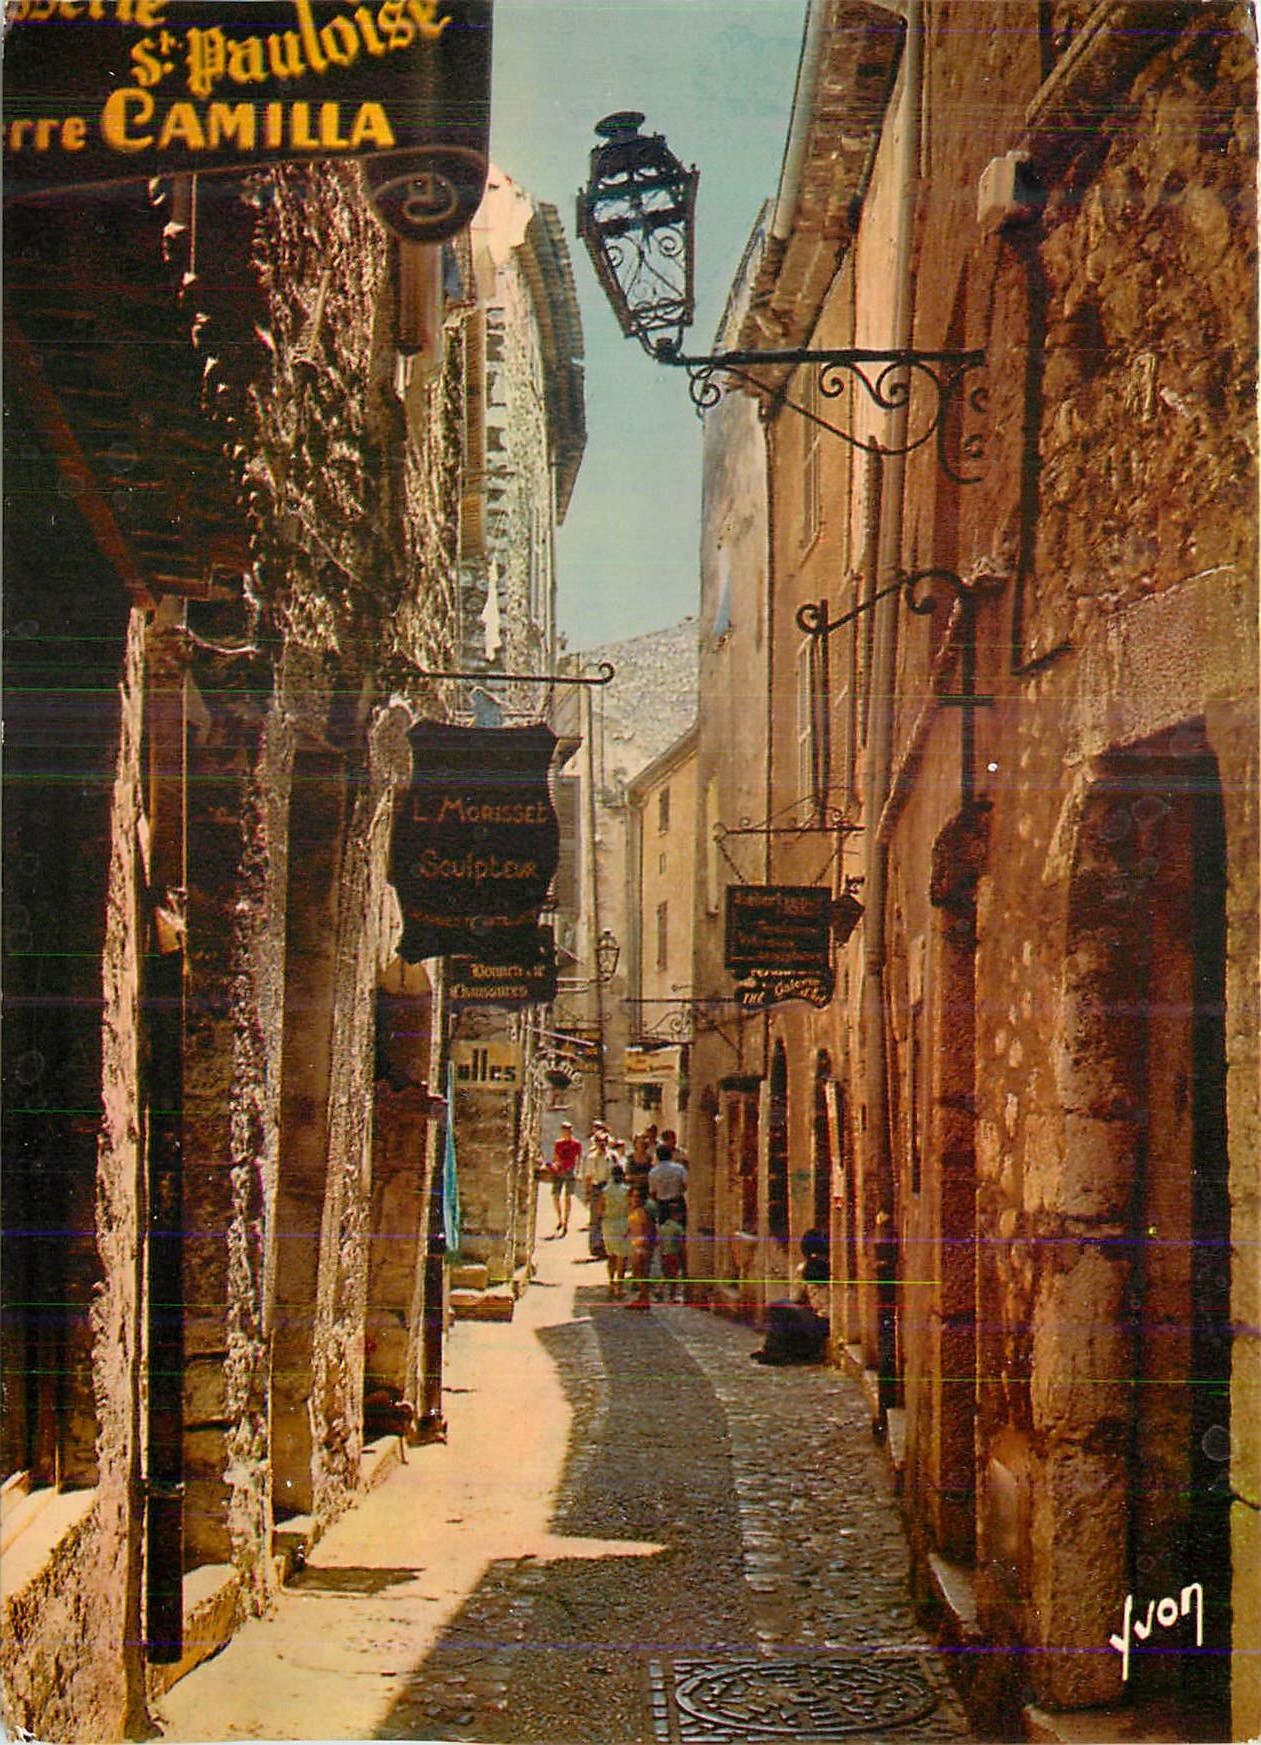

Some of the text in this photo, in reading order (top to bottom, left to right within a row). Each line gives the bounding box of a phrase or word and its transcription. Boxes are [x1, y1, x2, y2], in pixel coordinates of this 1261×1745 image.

[186, 0, 452, 97] Pauloise
[3, 87, 397, 151] rre CAMILLA
